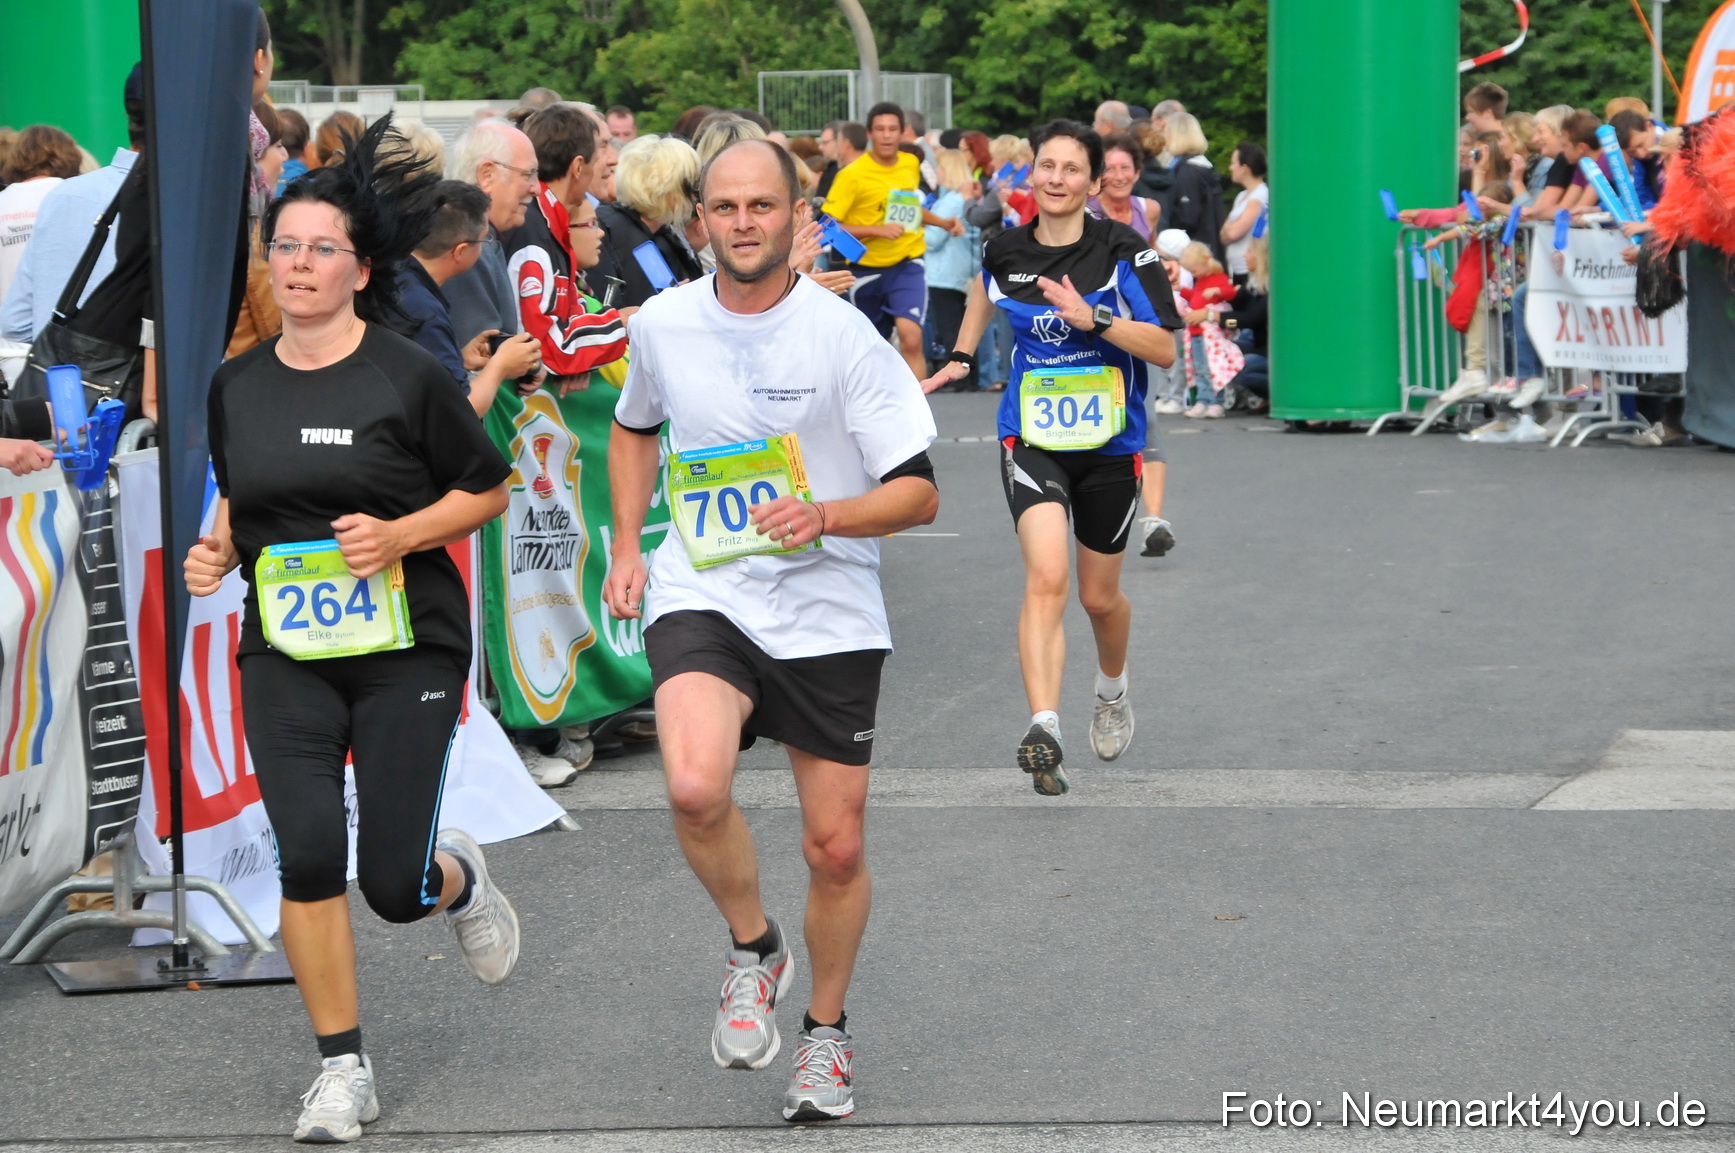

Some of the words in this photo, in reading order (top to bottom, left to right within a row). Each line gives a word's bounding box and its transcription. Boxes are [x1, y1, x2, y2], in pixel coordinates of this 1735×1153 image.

[889, 204, 916, 223] 209
[1008, 273, 1038, 283] saller
[1033, 395, 1104, 429] 304
[300, 428, 353, 445] THULE
[1046, 430, 1077, 439] Brigitte
[683, 470, 724, 485] firmenlauf
[717, 535, 743, 548] Fritz
[276, 565, 320, 579] firmenlauf
[276, 578, 378, 631] 264
[307, 630, 332, 641] Elke
[429, 690, 446, 700] asics
